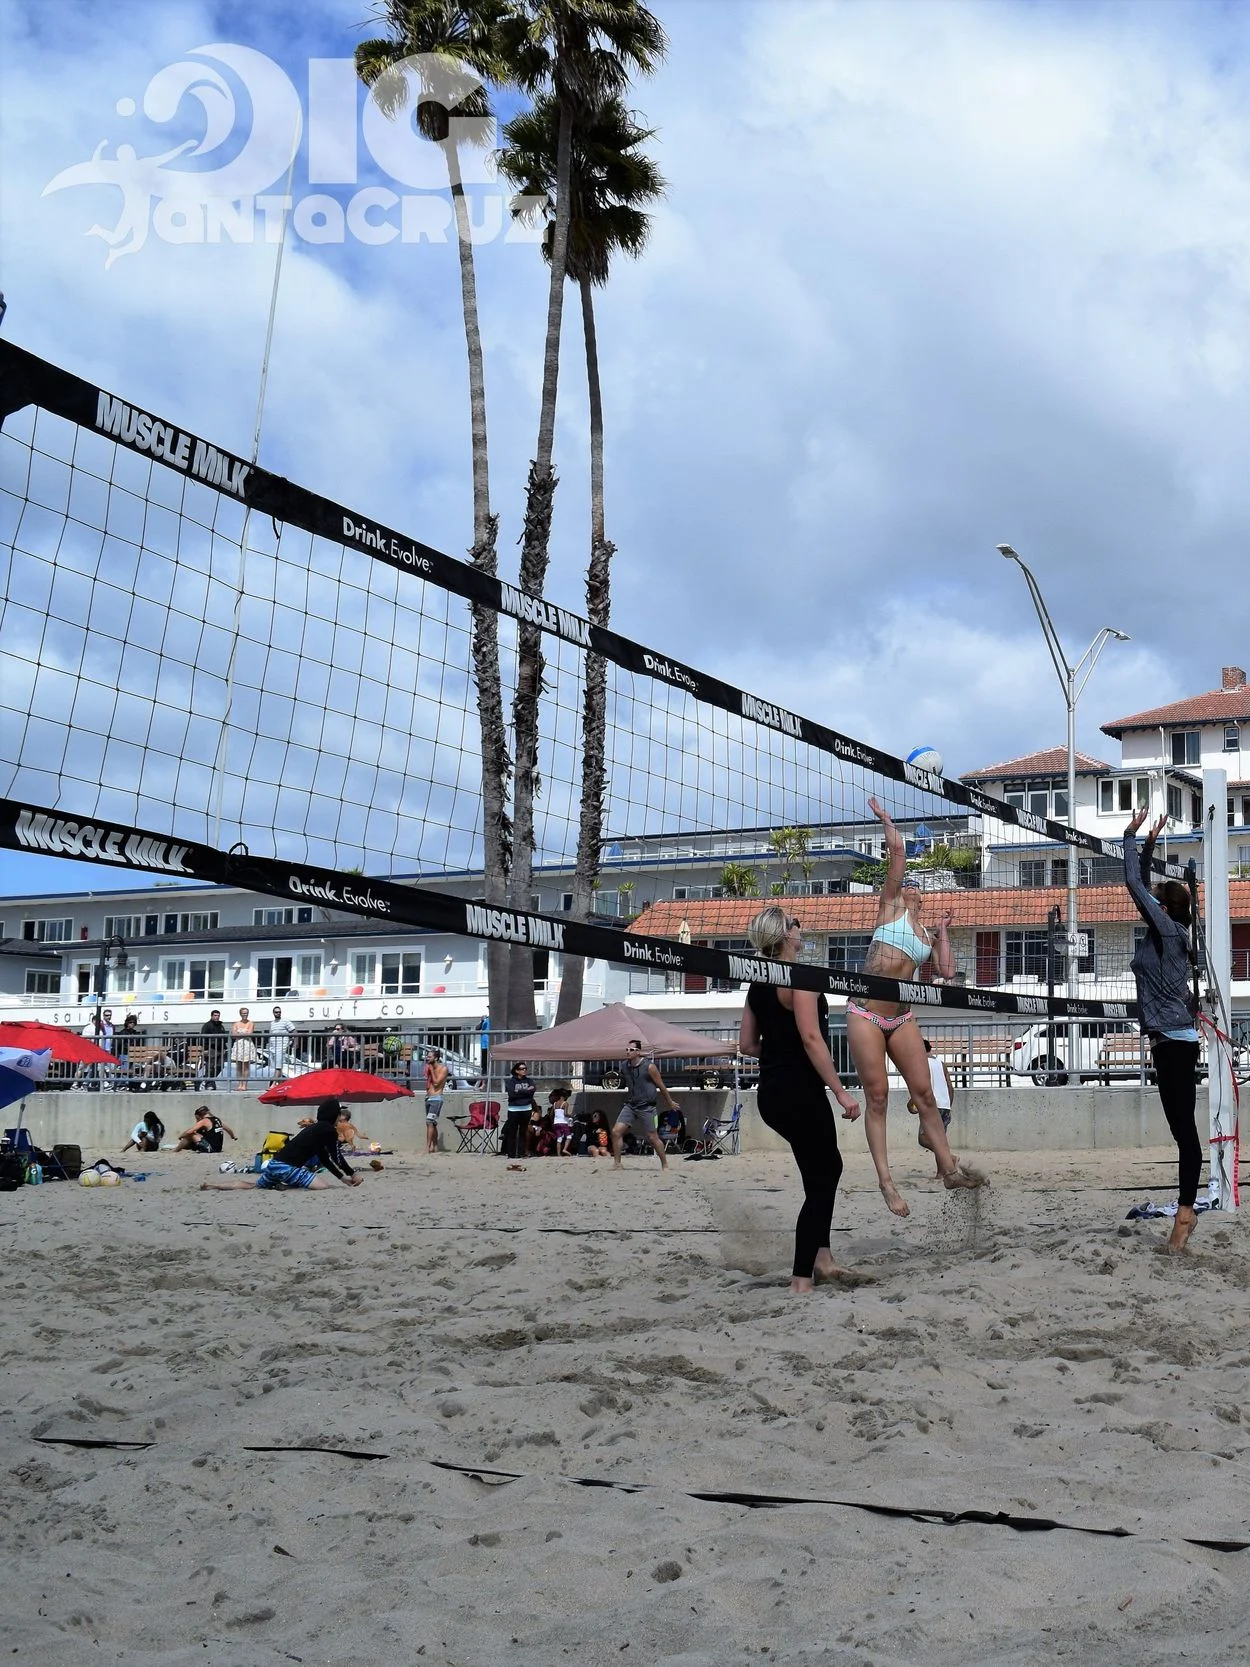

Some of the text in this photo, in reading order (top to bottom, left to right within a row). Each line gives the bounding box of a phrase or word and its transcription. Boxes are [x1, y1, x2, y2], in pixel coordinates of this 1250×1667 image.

[95, 390, 250, 498] MUSCLE MILK
[501, 581, 593, 648] MUSCLE MILK
[741, 692, 803, 738] MUSCLE MILK
[15, 809, 195, 874] MUSCLE MILK
[465, 903, 565, 950] MUSCLE MILK
[728, 954, 792, 987] MUSCLE MILK
[898, 982, 942, 1005] MUSCLE MILK
